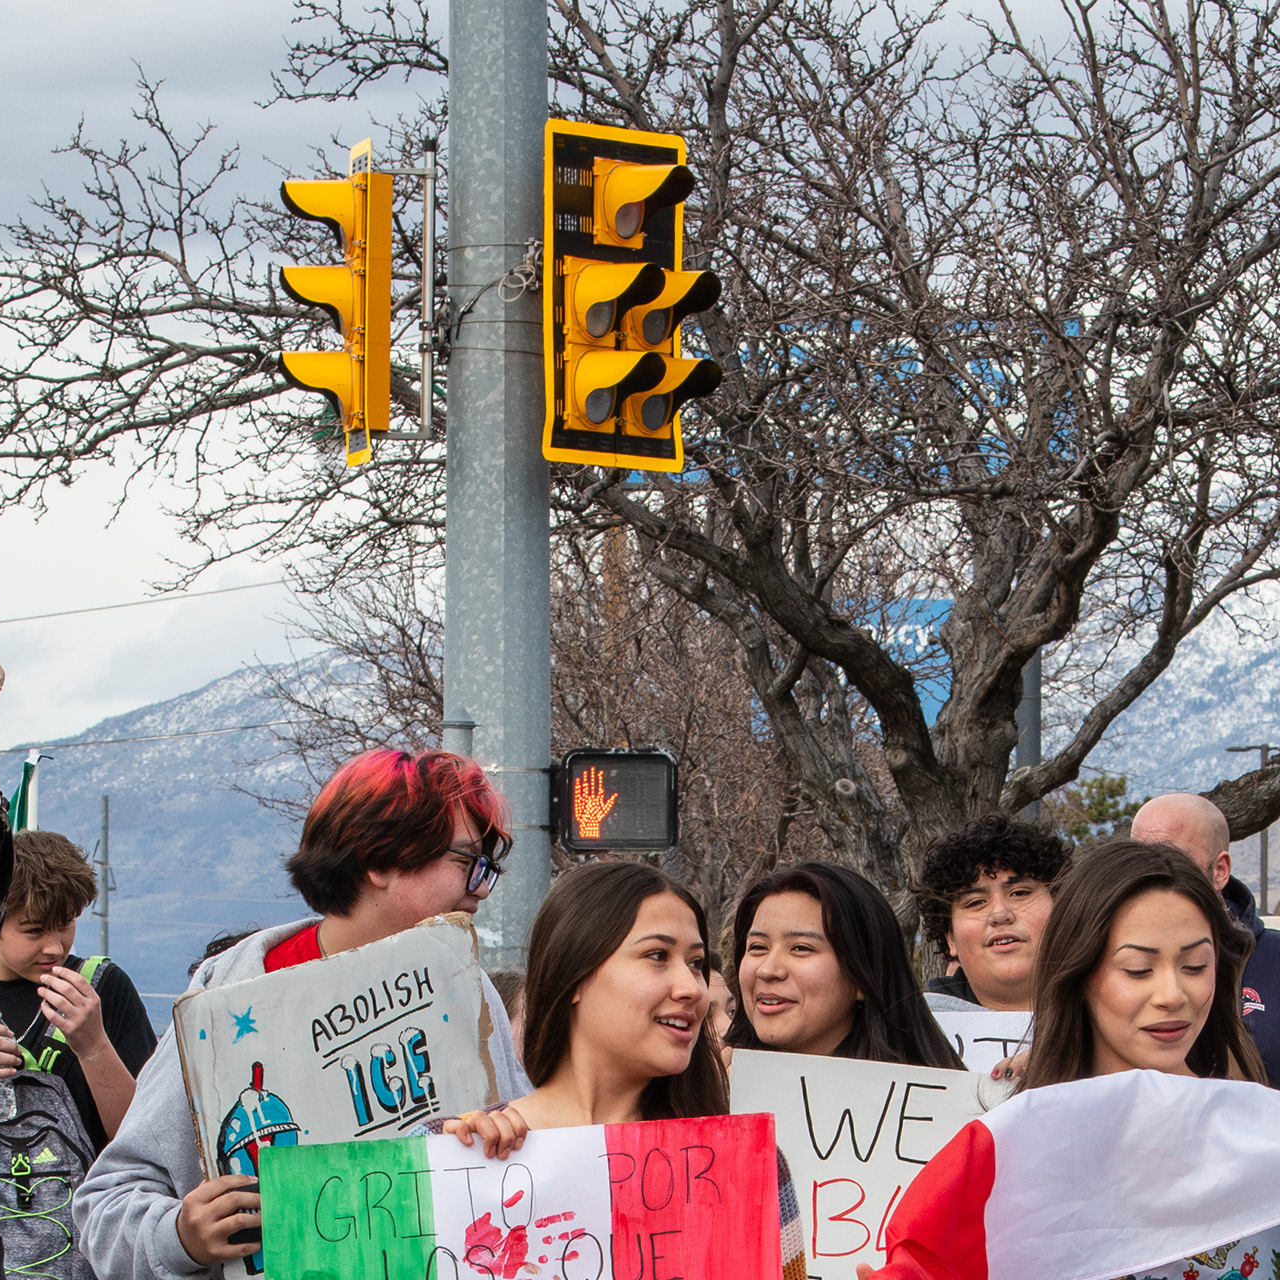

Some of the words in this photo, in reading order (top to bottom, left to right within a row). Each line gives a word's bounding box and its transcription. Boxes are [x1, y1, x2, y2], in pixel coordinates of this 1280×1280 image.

[311, 967, 435, 1053] ABOLISH
[340, 1026, 437, 1127] ICE
[800, 1075, 947, 1166] WE
[314, 1161, 536, 1243] GRITO
[598, 1144, 722, 1212] POR
